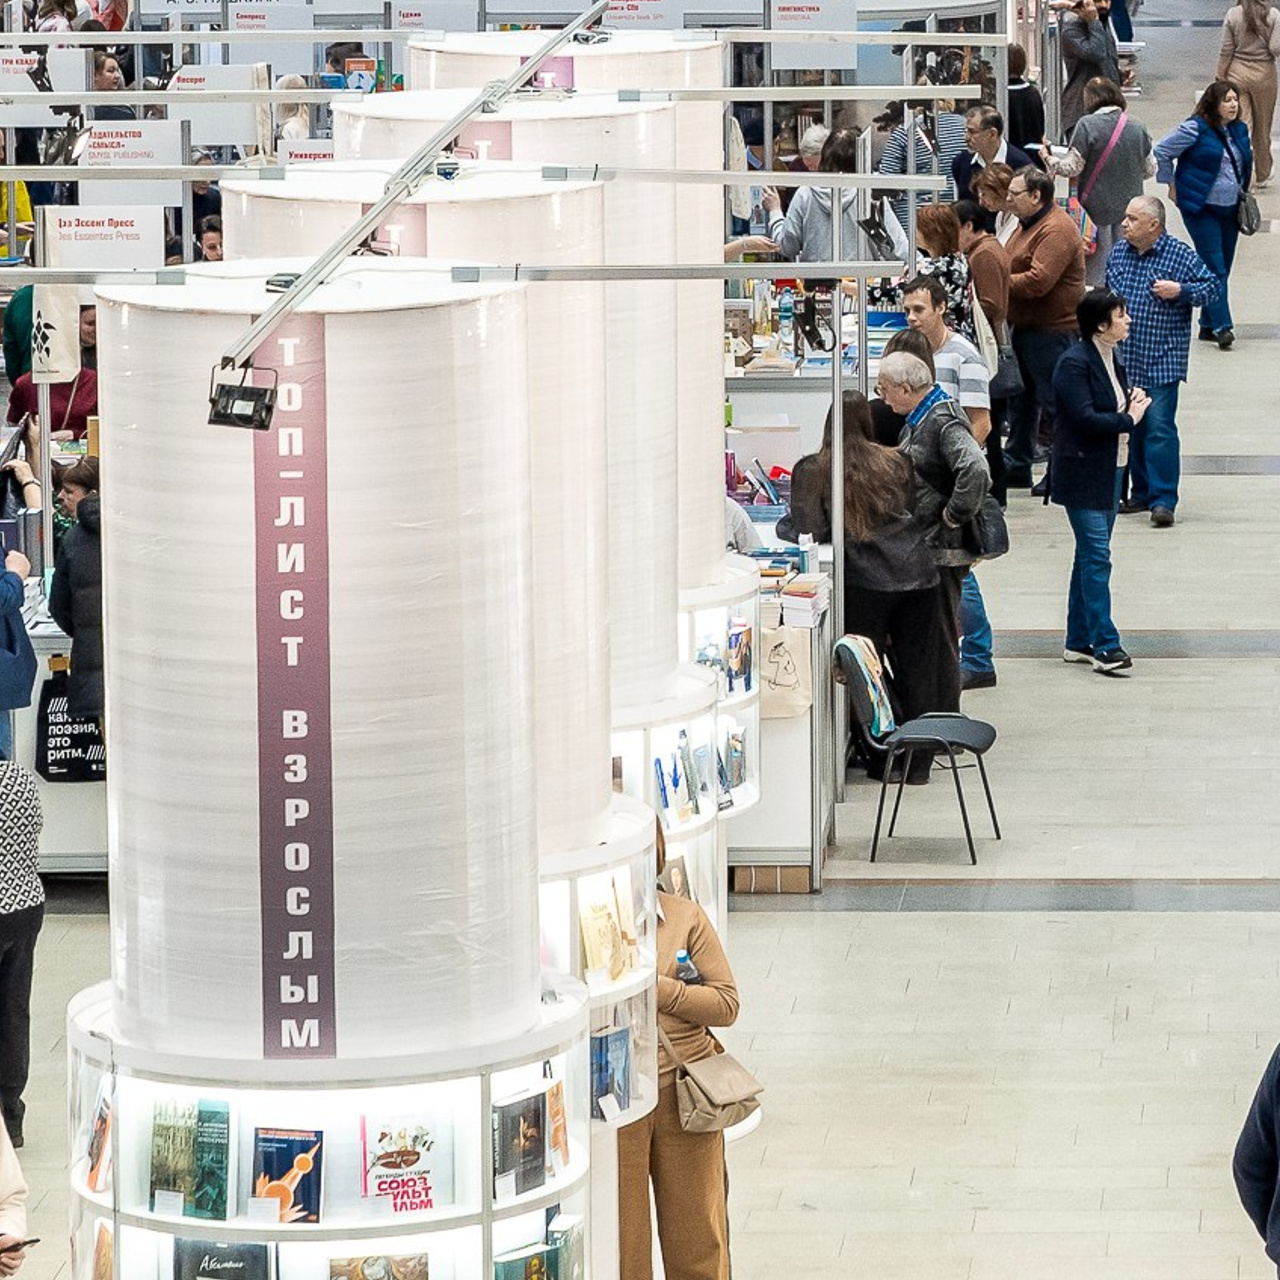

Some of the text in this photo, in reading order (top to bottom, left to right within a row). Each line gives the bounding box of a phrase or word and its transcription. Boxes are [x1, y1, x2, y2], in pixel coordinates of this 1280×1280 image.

[289, 150, 334, 160] Университ
[274, 337, 305, 667] ТОП-ЛИСТ
[48, 723, 98, 735] поэзия,
[47, 737, 71, 748] это
[280, 710, 320, 1049] ВЗРОСЛЫМ
[377, 1177, 428, 1192] СОЮЗ
[391, 1186, 432, 1201] УЛЬТ
[393, 1198, 433, 1212] ЛЬМ
